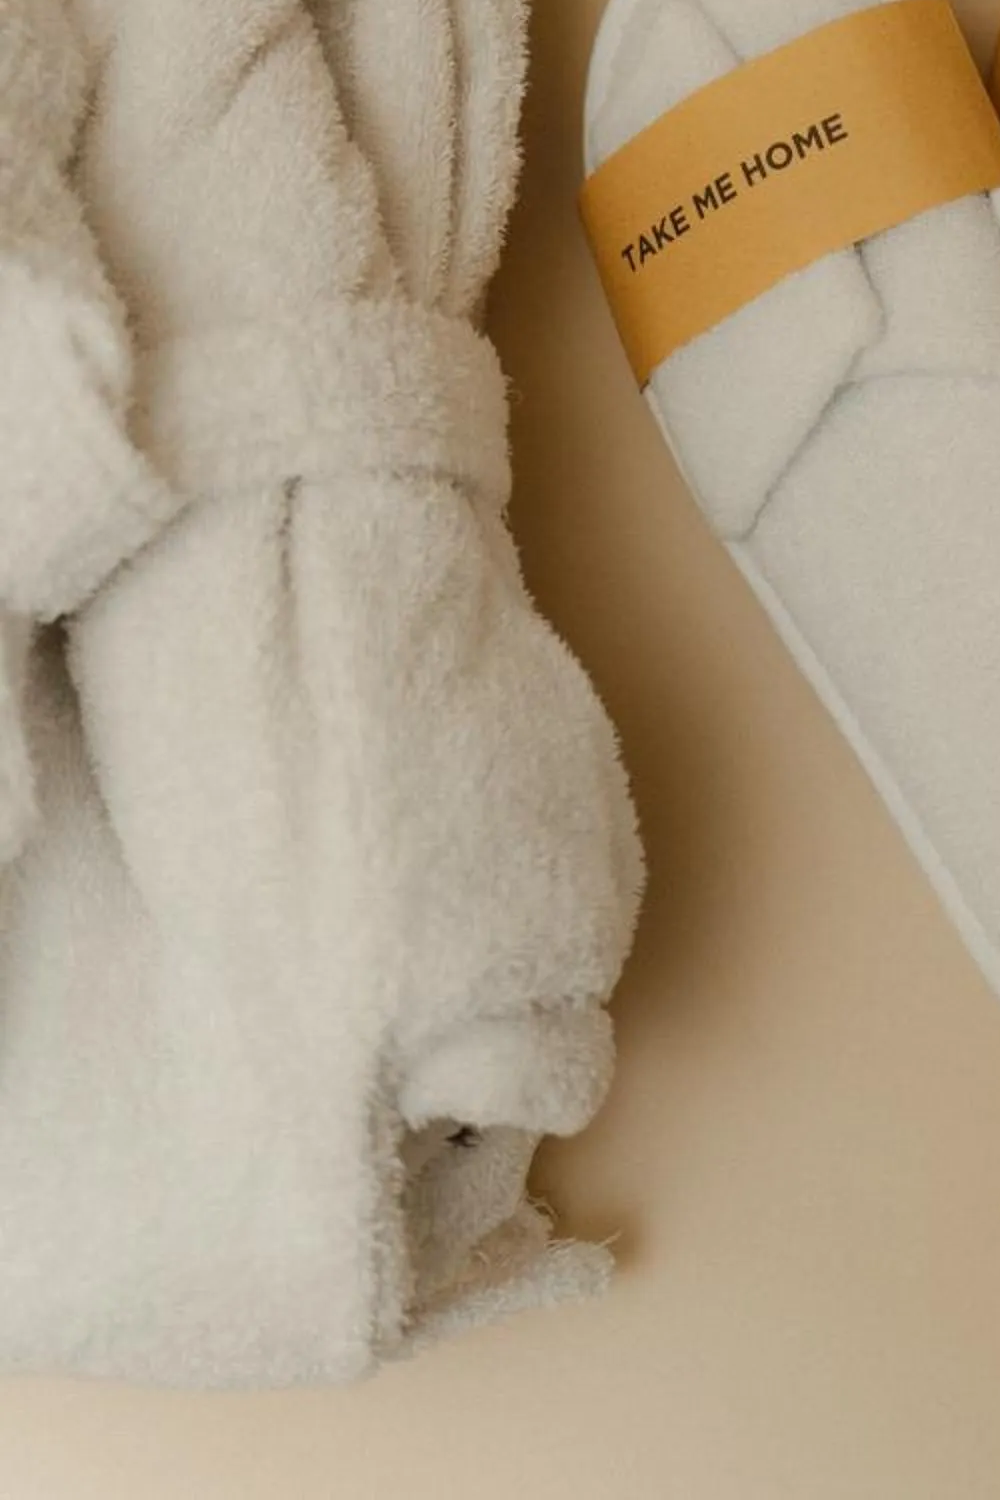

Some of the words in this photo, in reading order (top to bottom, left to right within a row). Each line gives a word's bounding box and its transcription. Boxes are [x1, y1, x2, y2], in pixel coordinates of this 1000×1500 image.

[620, 204, 692, 274] TAKE
[690, 171, 739, 221] ME
[738, 112, 849, 188] HOME
